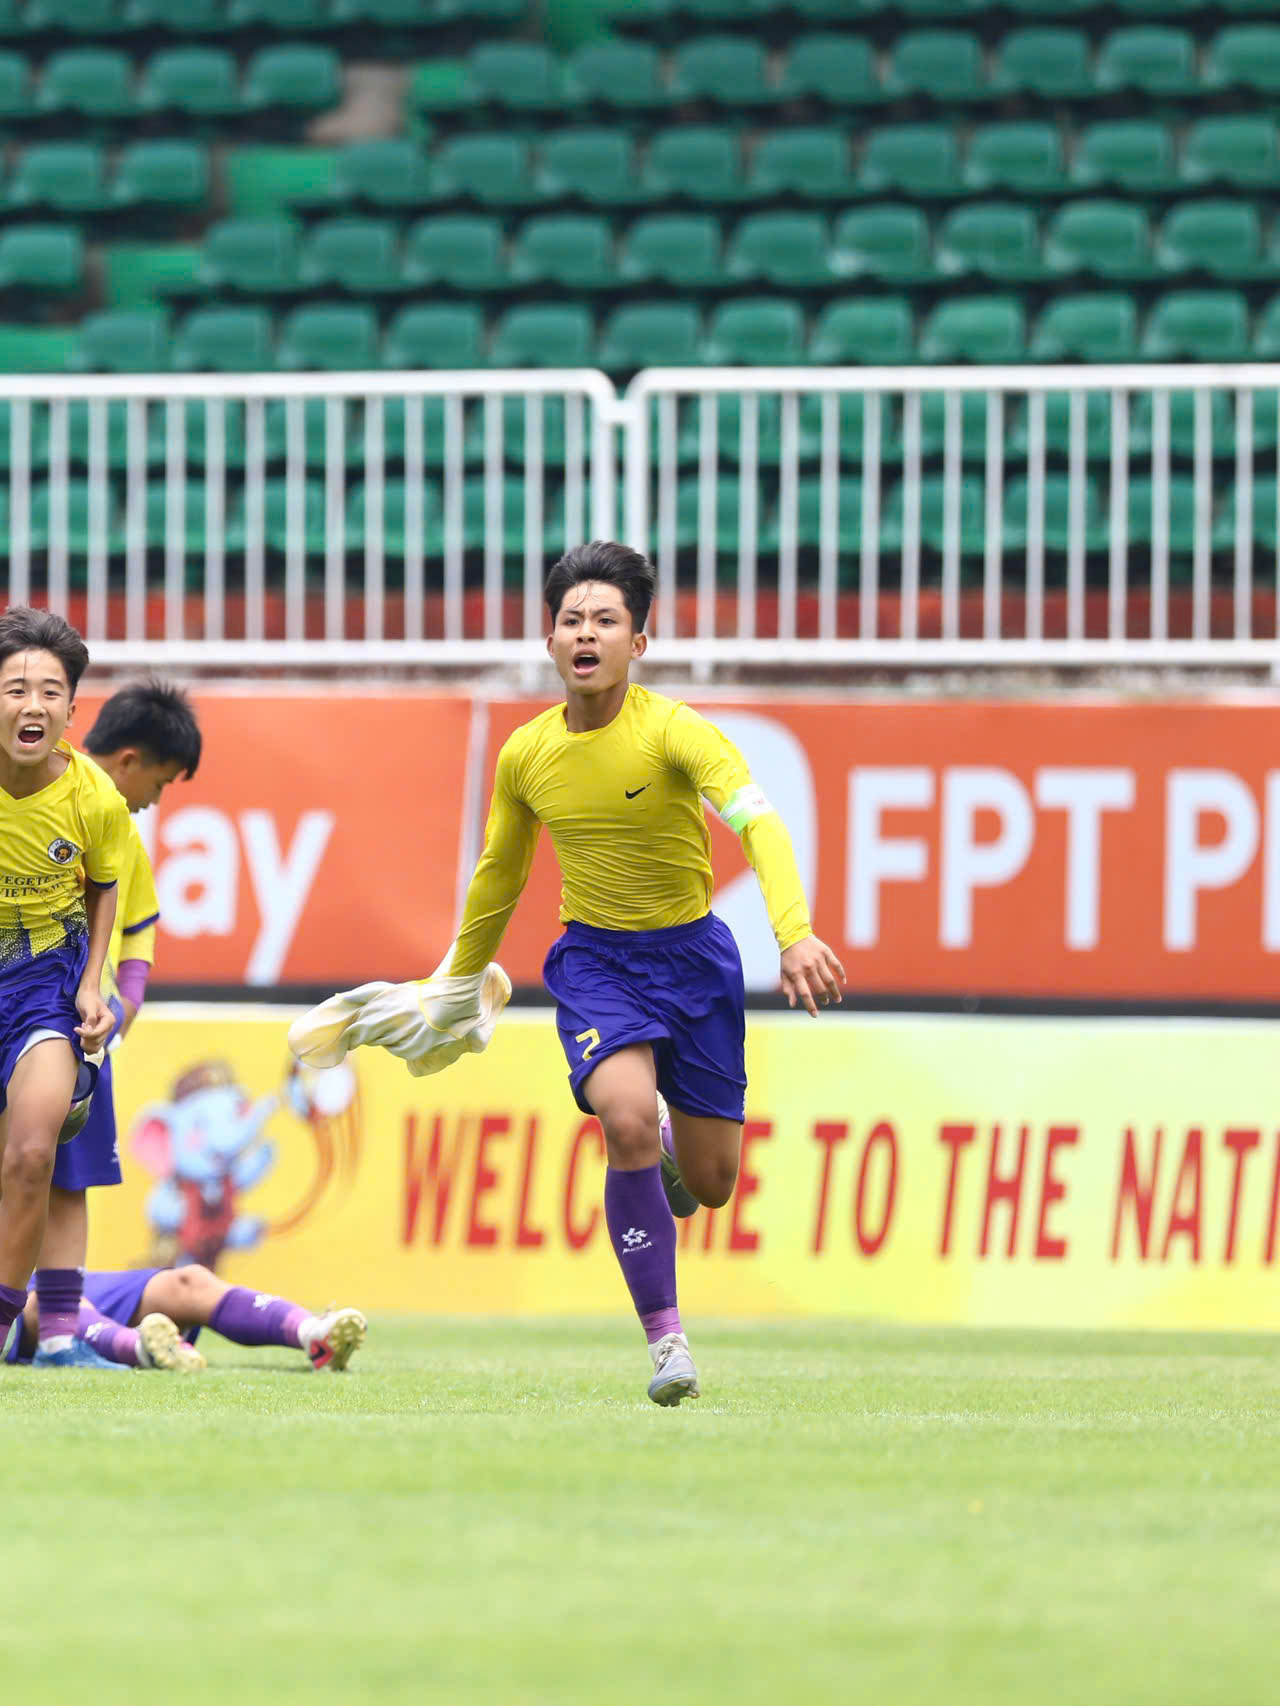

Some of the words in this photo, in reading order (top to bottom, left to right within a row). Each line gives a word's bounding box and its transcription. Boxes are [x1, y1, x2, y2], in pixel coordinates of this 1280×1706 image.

[132, 803, 335, 986] ay
[844, 764, 1136, 951] FPT
[575, 1027, 601, 1062] 7
[403, 1113, 773, 1254] WELCE
[811, 1119, 898, 1256] TO
[936, 1122, 1081, 1261] THE
